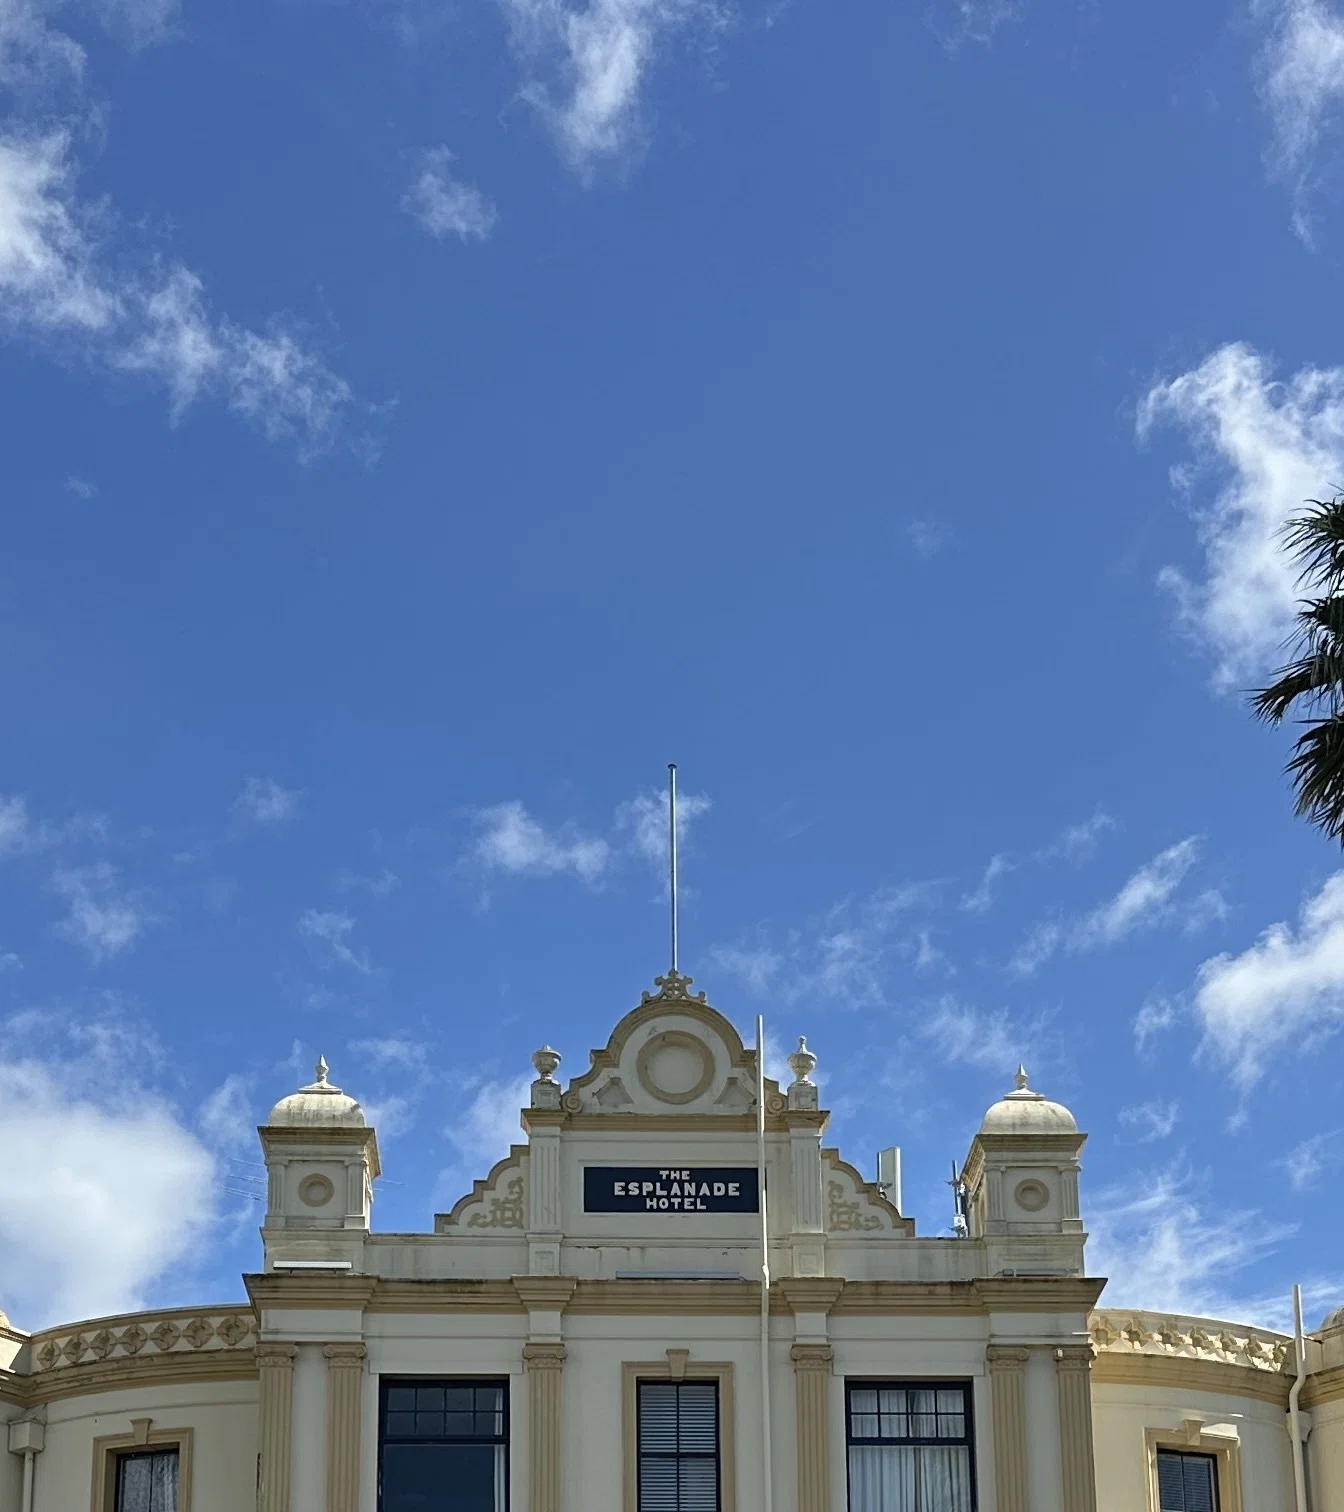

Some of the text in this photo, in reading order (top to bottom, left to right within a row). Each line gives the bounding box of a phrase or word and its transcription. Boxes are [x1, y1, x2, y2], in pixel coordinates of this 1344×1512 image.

[659, 1170, 690, 1180] THE
[613, 1182, 740, 1197] ESPLANADE
[645, 1198, 707, 1210] HOTEL
